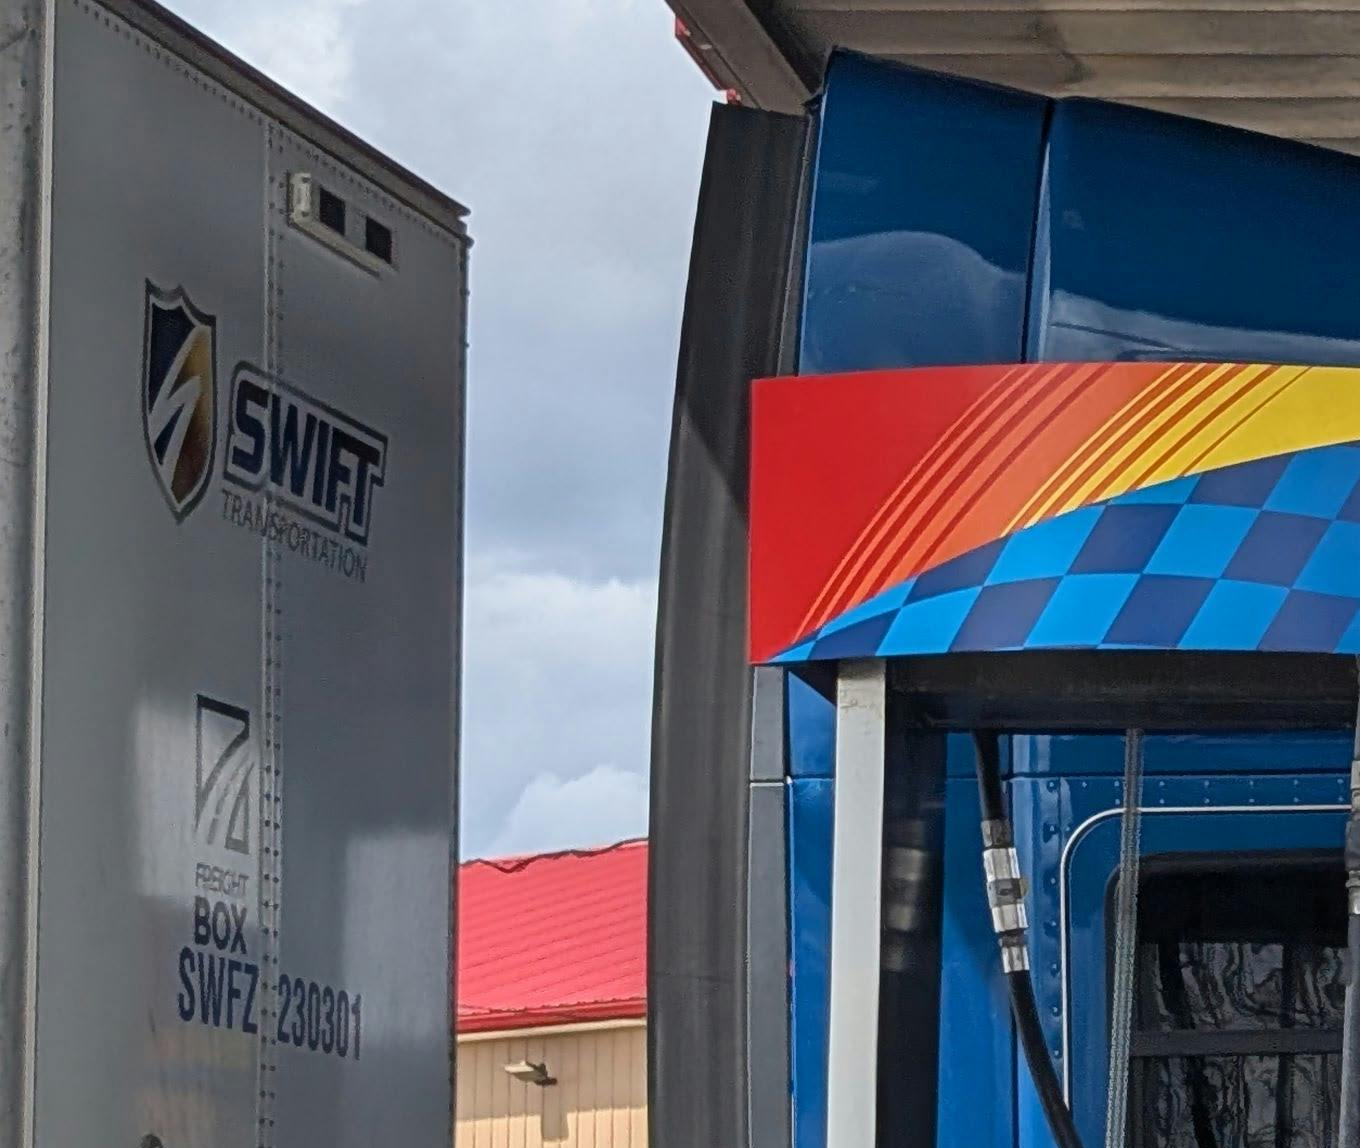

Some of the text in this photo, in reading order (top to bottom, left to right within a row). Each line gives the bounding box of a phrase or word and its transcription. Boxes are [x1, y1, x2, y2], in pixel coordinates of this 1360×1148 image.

[231, 378, 382, 529] SWIFT
[222, 487, 367, 583] TRANSPORTATION
[194, 896, 247, 954] BOX
[178, 947, 362, 1061] SWFZ 230301
